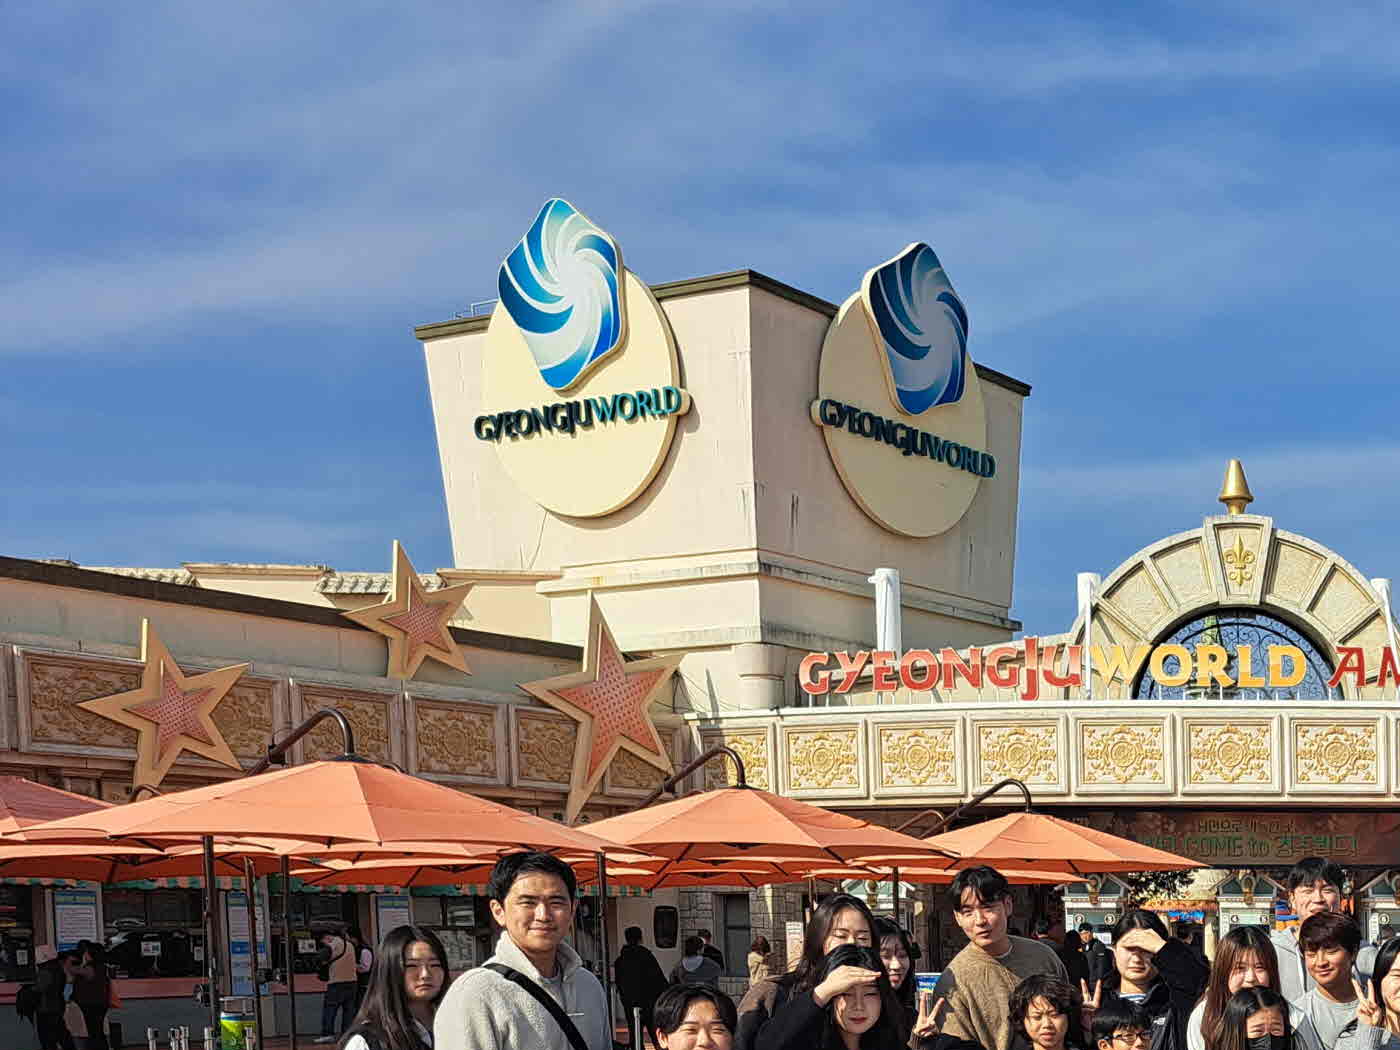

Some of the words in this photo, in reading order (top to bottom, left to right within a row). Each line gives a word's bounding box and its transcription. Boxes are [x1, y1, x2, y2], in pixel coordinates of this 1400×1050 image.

[474, 385, 682, 441] GYEONGJUWORLD
[819, 399, 995, 478] GYEONGJUWORLD
[799, 636, 1082, 701] GYEONGJU
[1090, 643, 1307, 689] WORLD
